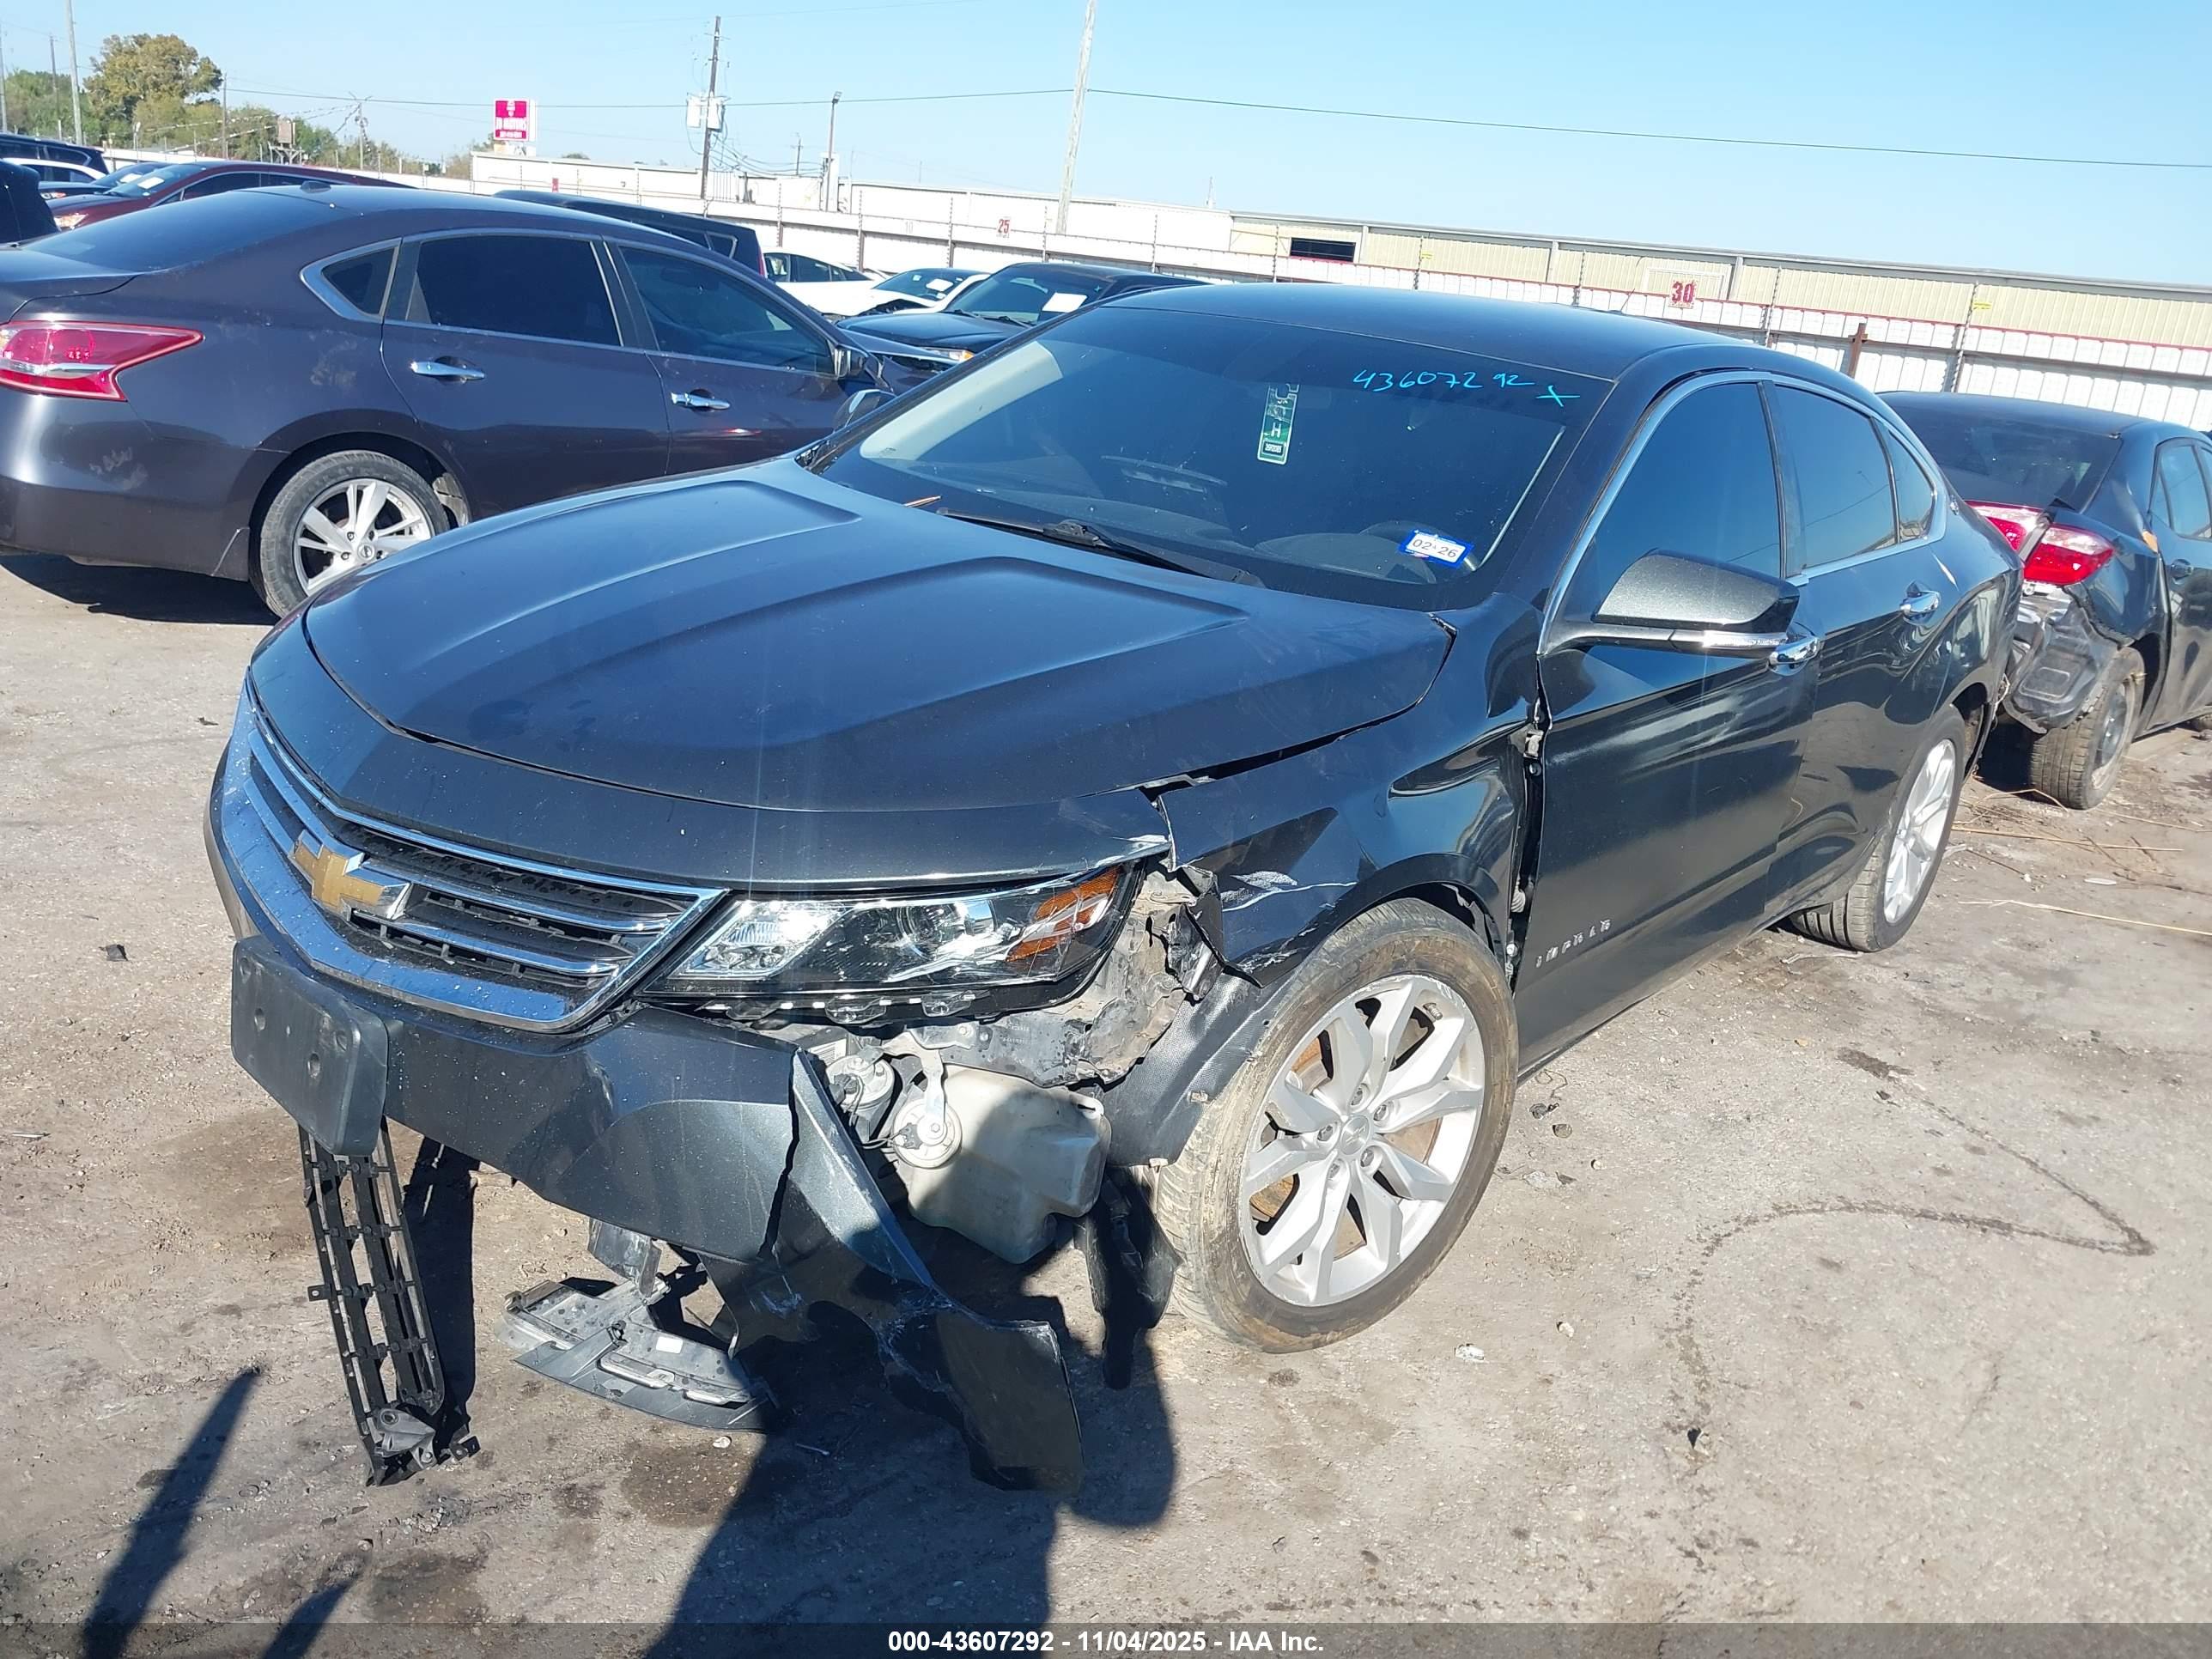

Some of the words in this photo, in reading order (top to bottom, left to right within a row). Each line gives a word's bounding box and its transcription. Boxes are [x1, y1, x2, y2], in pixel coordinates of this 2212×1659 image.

[998, 218, 1011, 234] 25
[1671, 281, 1694, 304] 30
[1412, 538, 1432, 551] 02
[1437, 546, 1458, 559] 26
